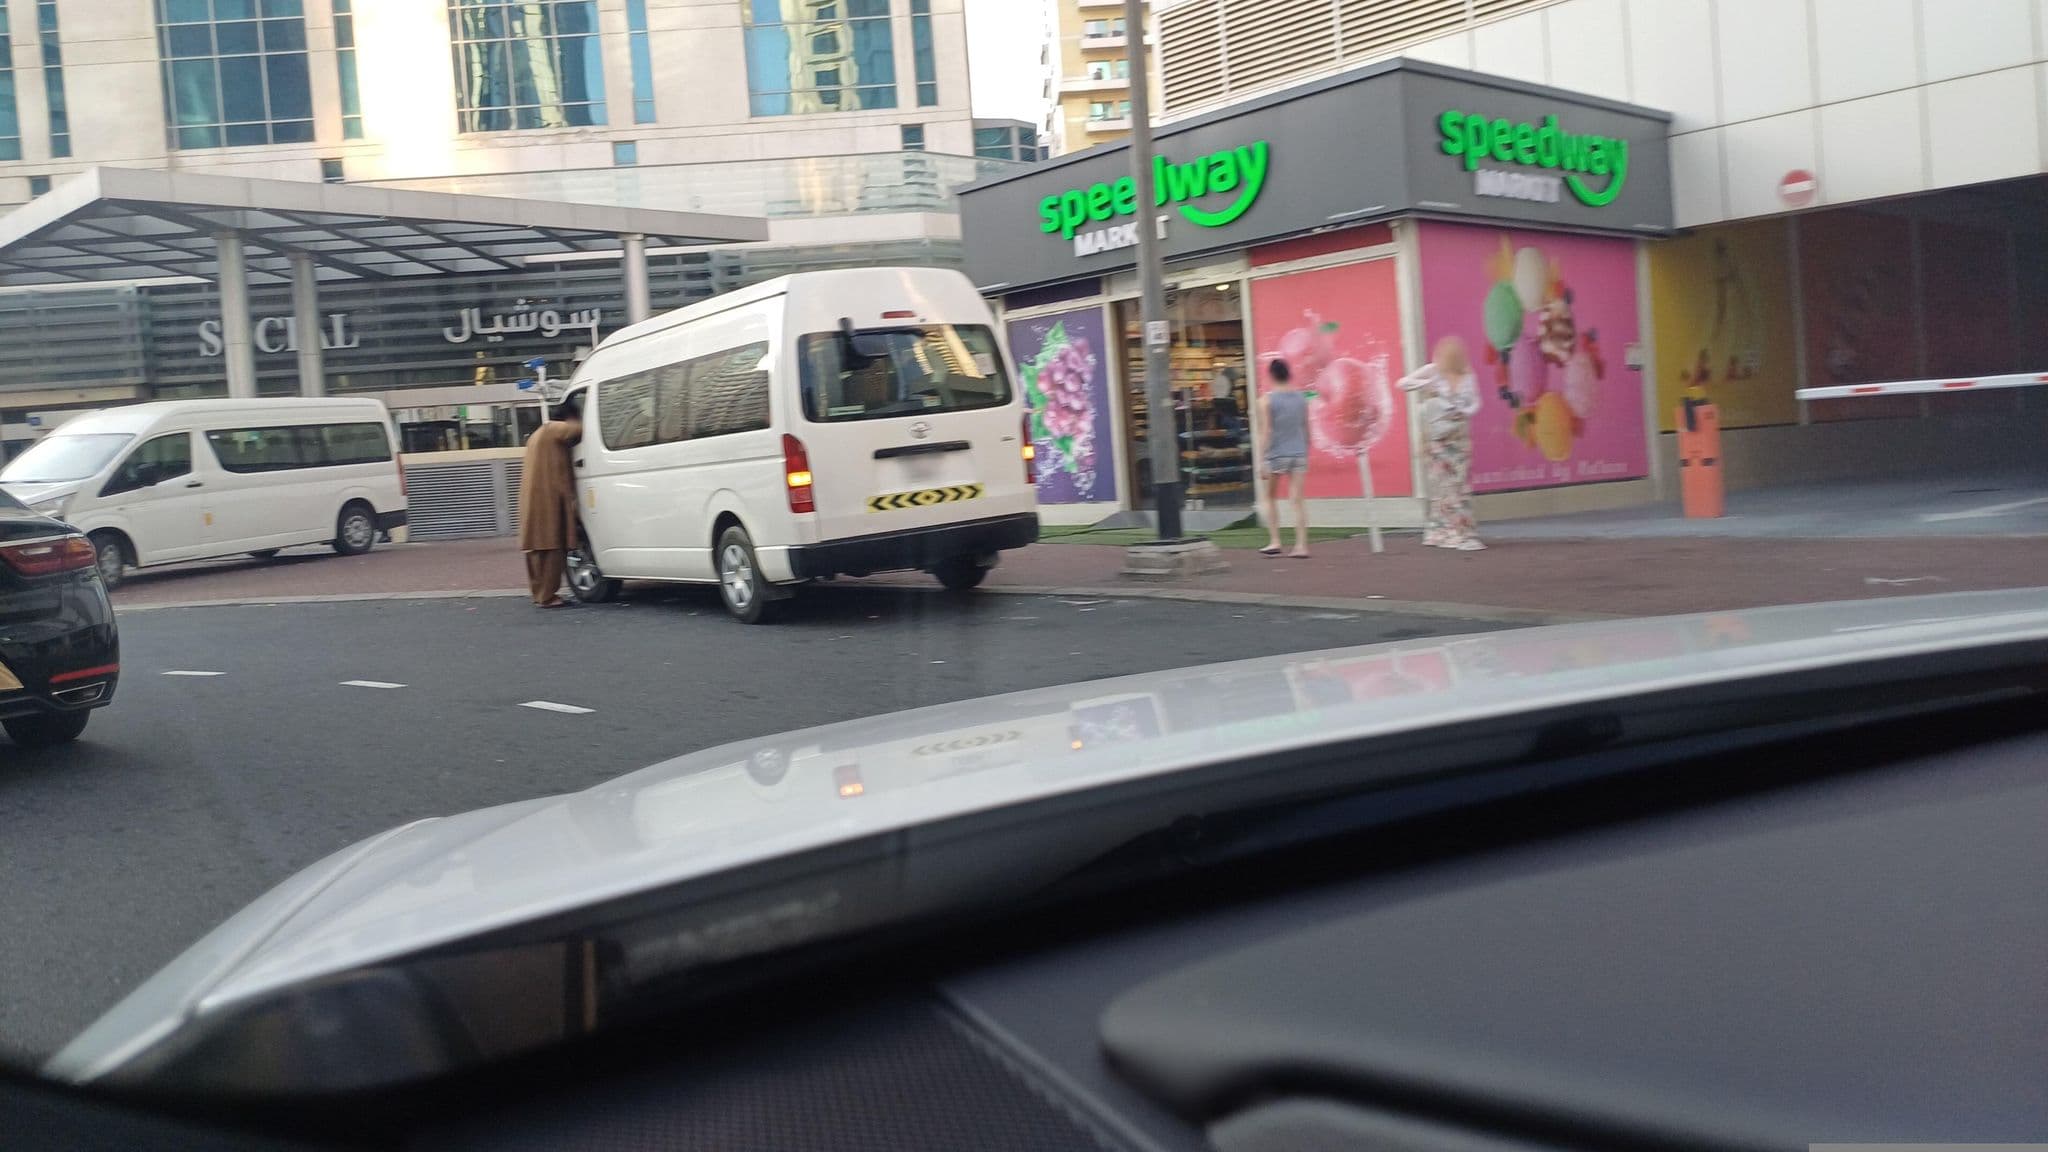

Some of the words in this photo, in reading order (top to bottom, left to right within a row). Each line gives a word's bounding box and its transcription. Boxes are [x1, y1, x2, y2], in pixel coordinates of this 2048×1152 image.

[1439, 110, 1628, 208] speedway
[1074, 214, 1170, 257] MARKT
[199, 313, 361, 357] SCIL
[443, 298, 600, 343] سوشيال
